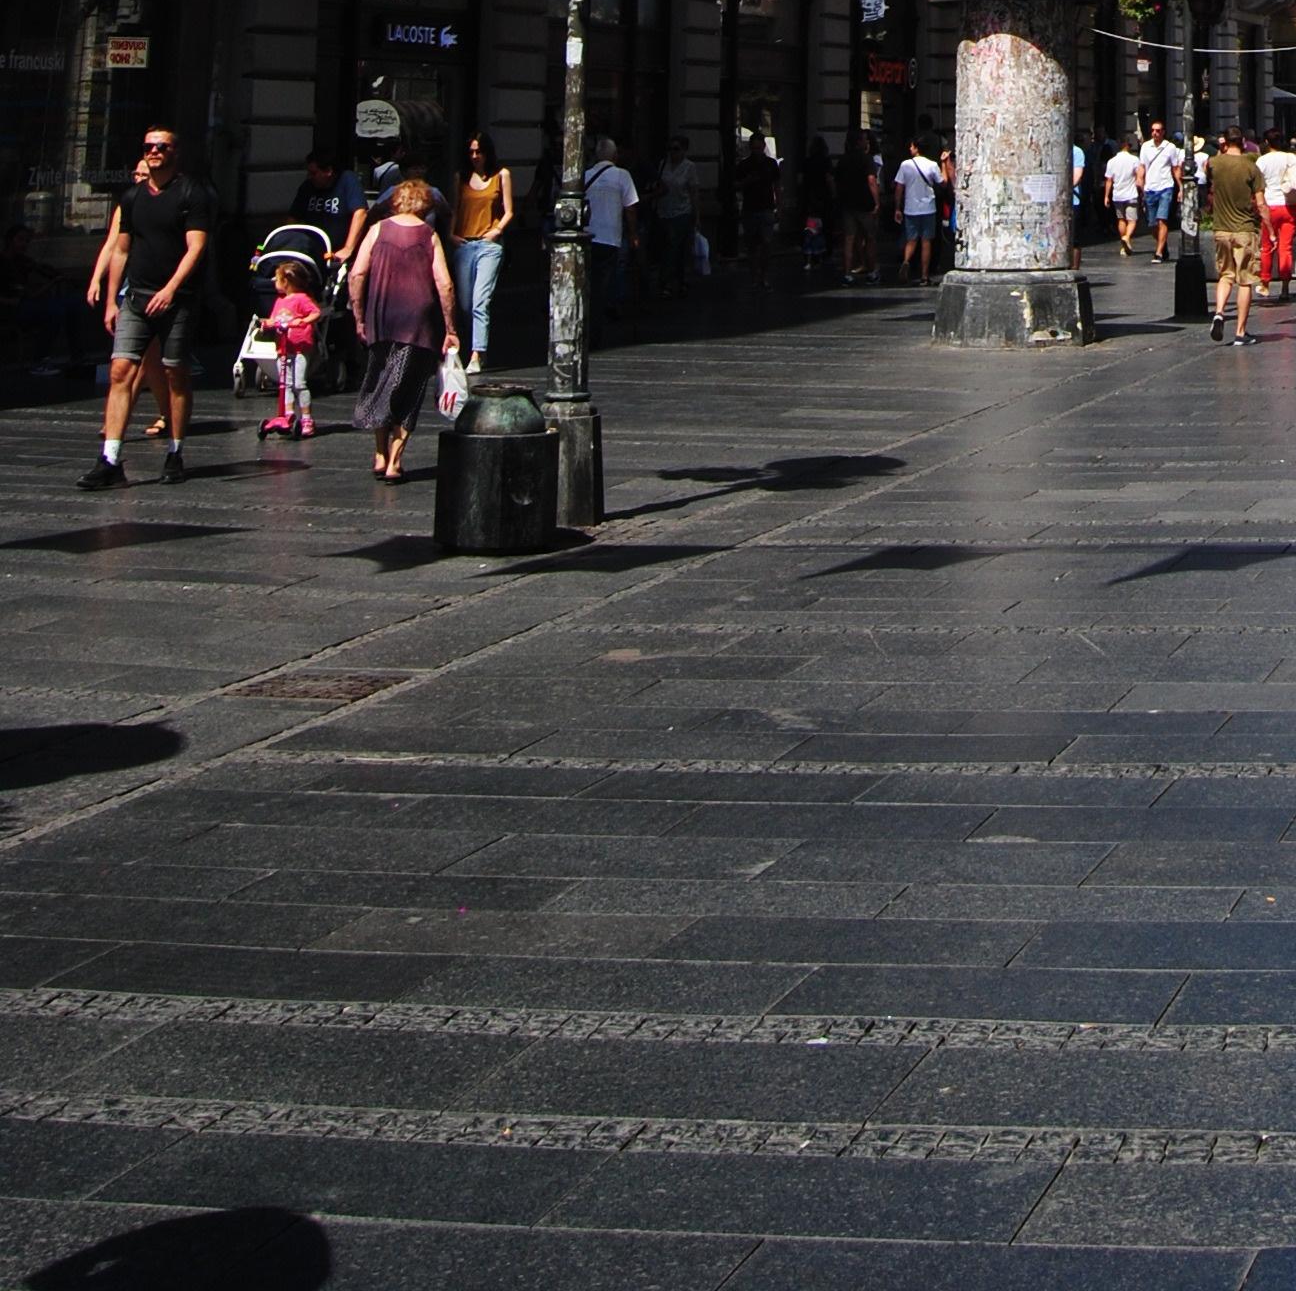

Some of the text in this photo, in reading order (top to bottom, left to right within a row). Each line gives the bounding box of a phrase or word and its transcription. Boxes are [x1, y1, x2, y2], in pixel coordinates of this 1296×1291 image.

[386, 23, 436, 45] LACOSTE
[9, 48, 65, 72] francuski
[307, 196, 340, 215] BEER
